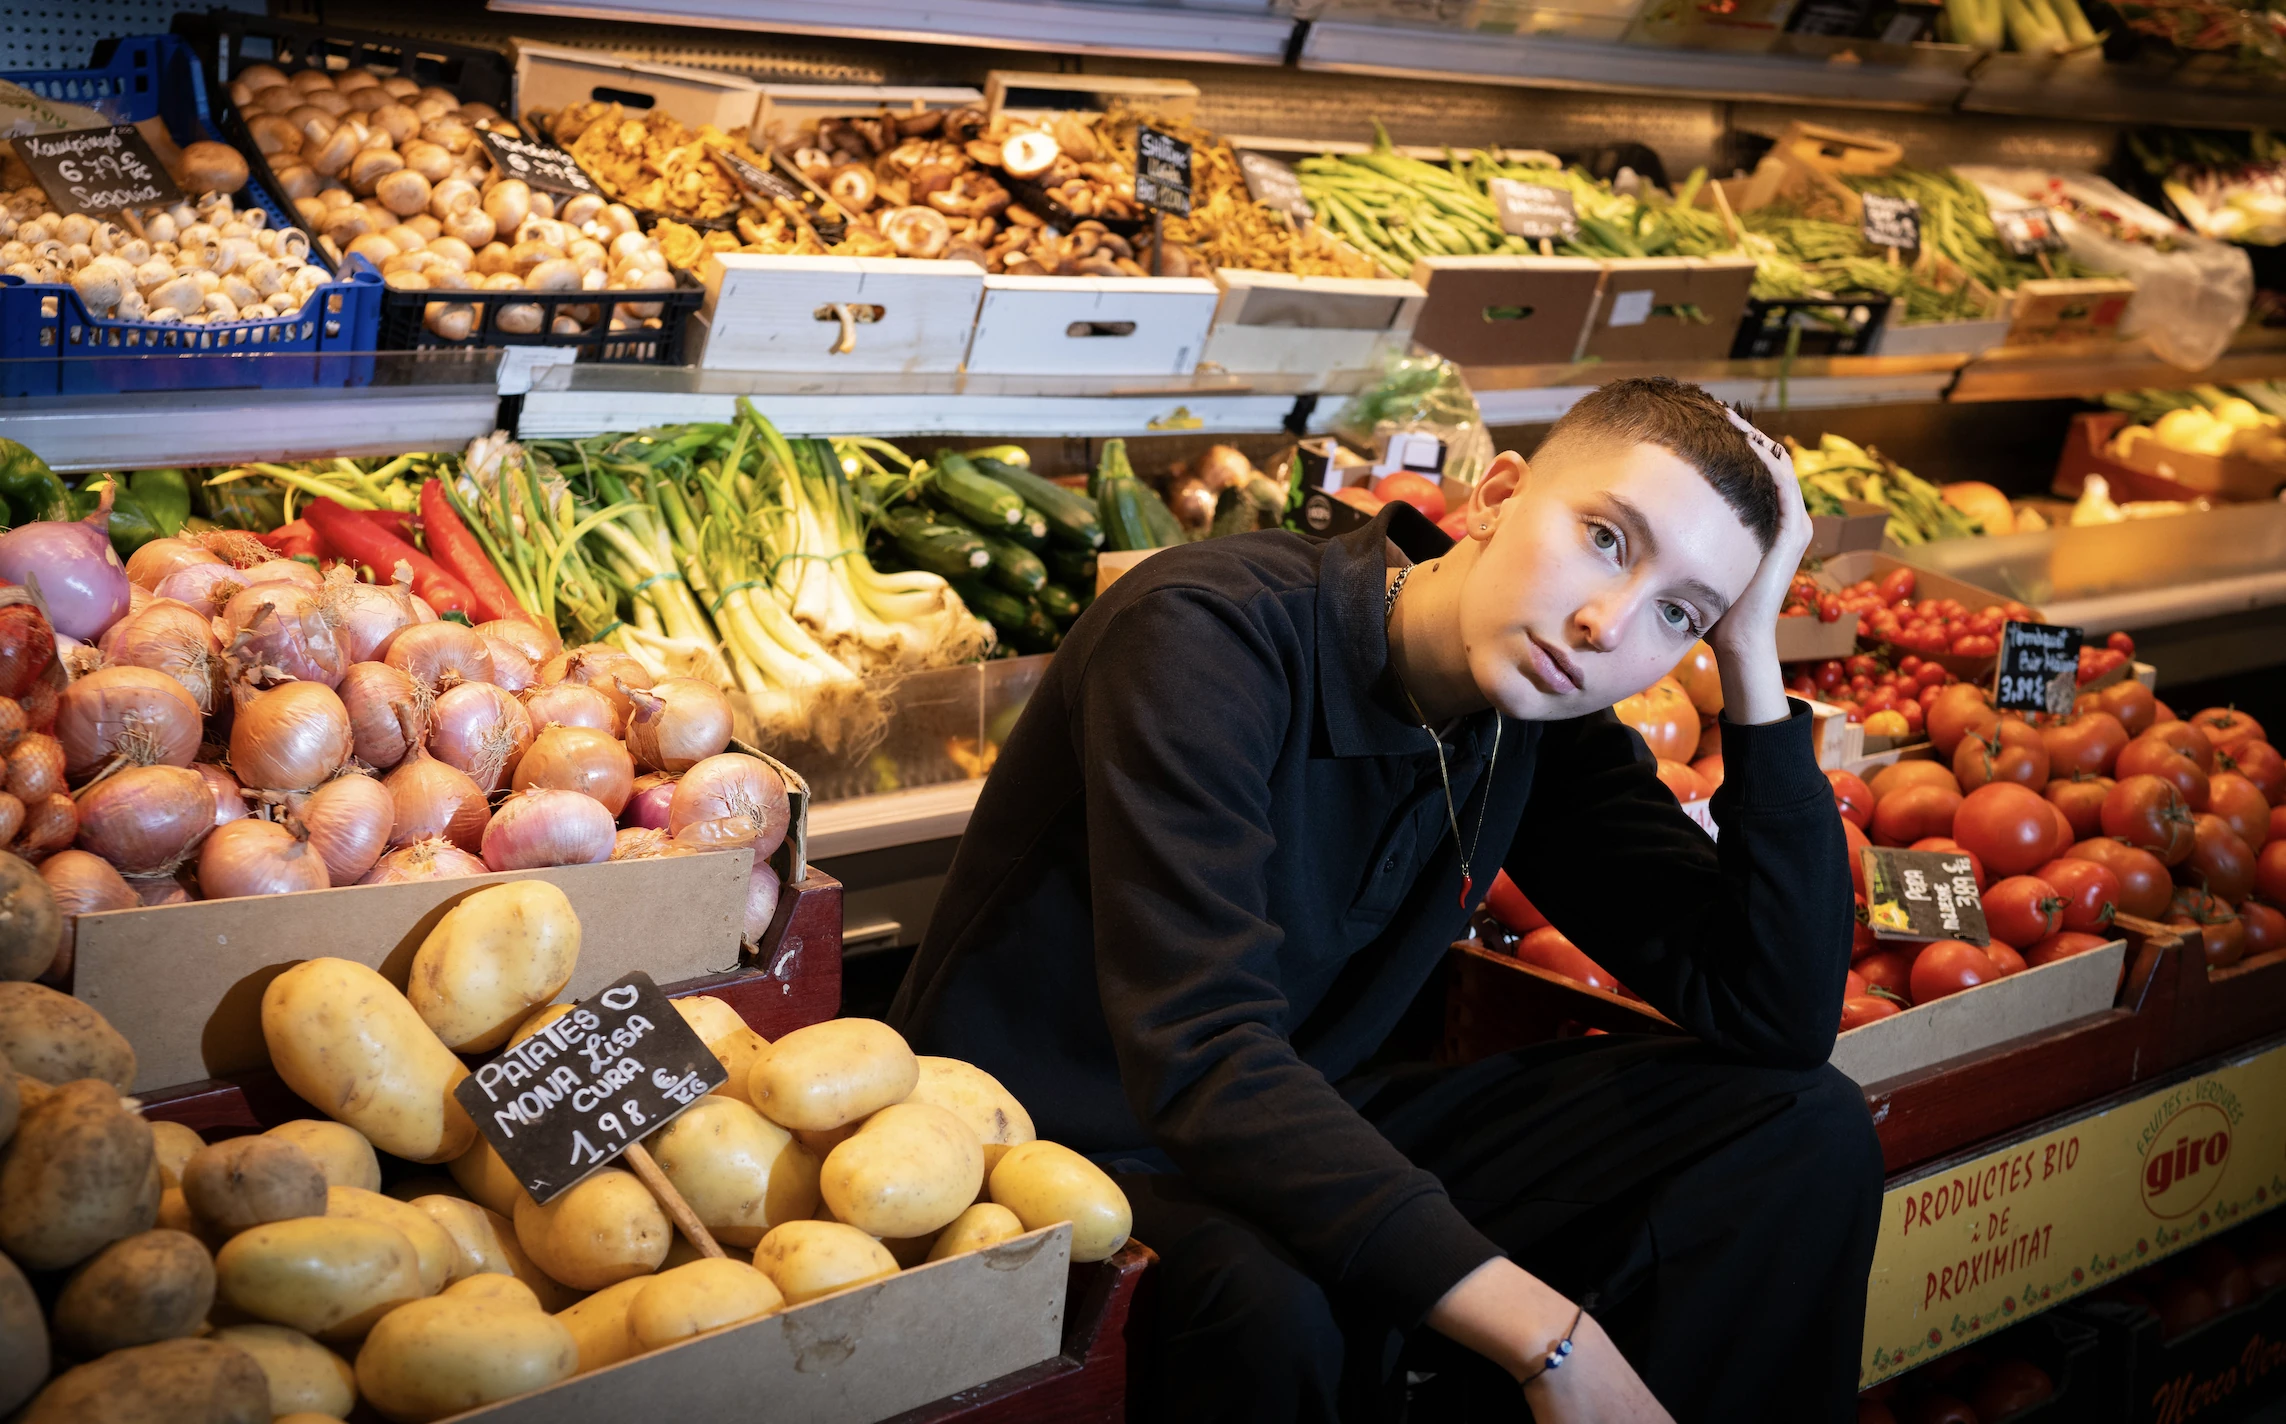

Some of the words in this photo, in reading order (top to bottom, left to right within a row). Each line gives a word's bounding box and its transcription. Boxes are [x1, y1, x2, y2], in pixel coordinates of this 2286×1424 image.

[475, 1009, 600, 1103] PATATES
[572, 1057, 646, 1113] CURA
[494, 1065, 583, 1139] MONA
[2137, 1091, 2182, 1157] FRUITES
[2196, 1080, 2244, 1126] VERDURES
[1903, 1150, 2035, 1237] PRODUCTES
[2042, 1136, 2079, 1182] BIO
[2146, 1131, 2229, 1198] giro
[1988, 1206, 2011, 1243] DE
[1924, 1223, 2053, 1312] PROXIMITAT
